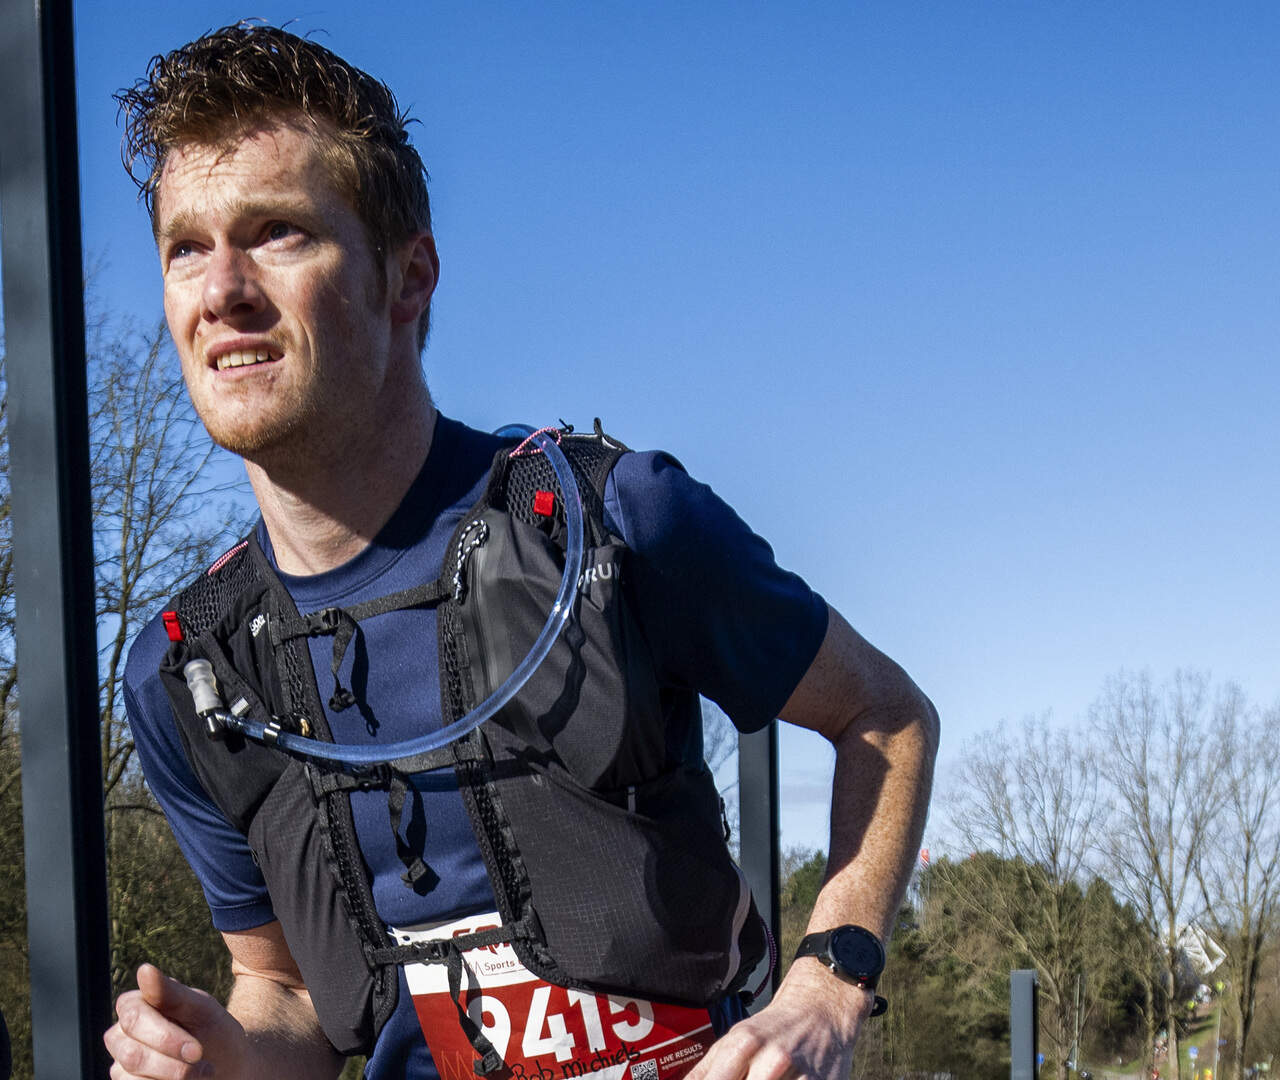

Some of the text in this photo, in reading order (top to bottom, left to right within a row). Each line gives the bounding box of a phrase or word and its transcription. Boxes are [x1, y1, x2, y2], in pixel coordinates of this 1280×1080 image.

[484, 959, 516, 973] Sports
[467, 986, 655, 1063] 9415
[660, 1053, 675, 1065] LIVE
[675, 1043, 703, 1059] RESULTS
